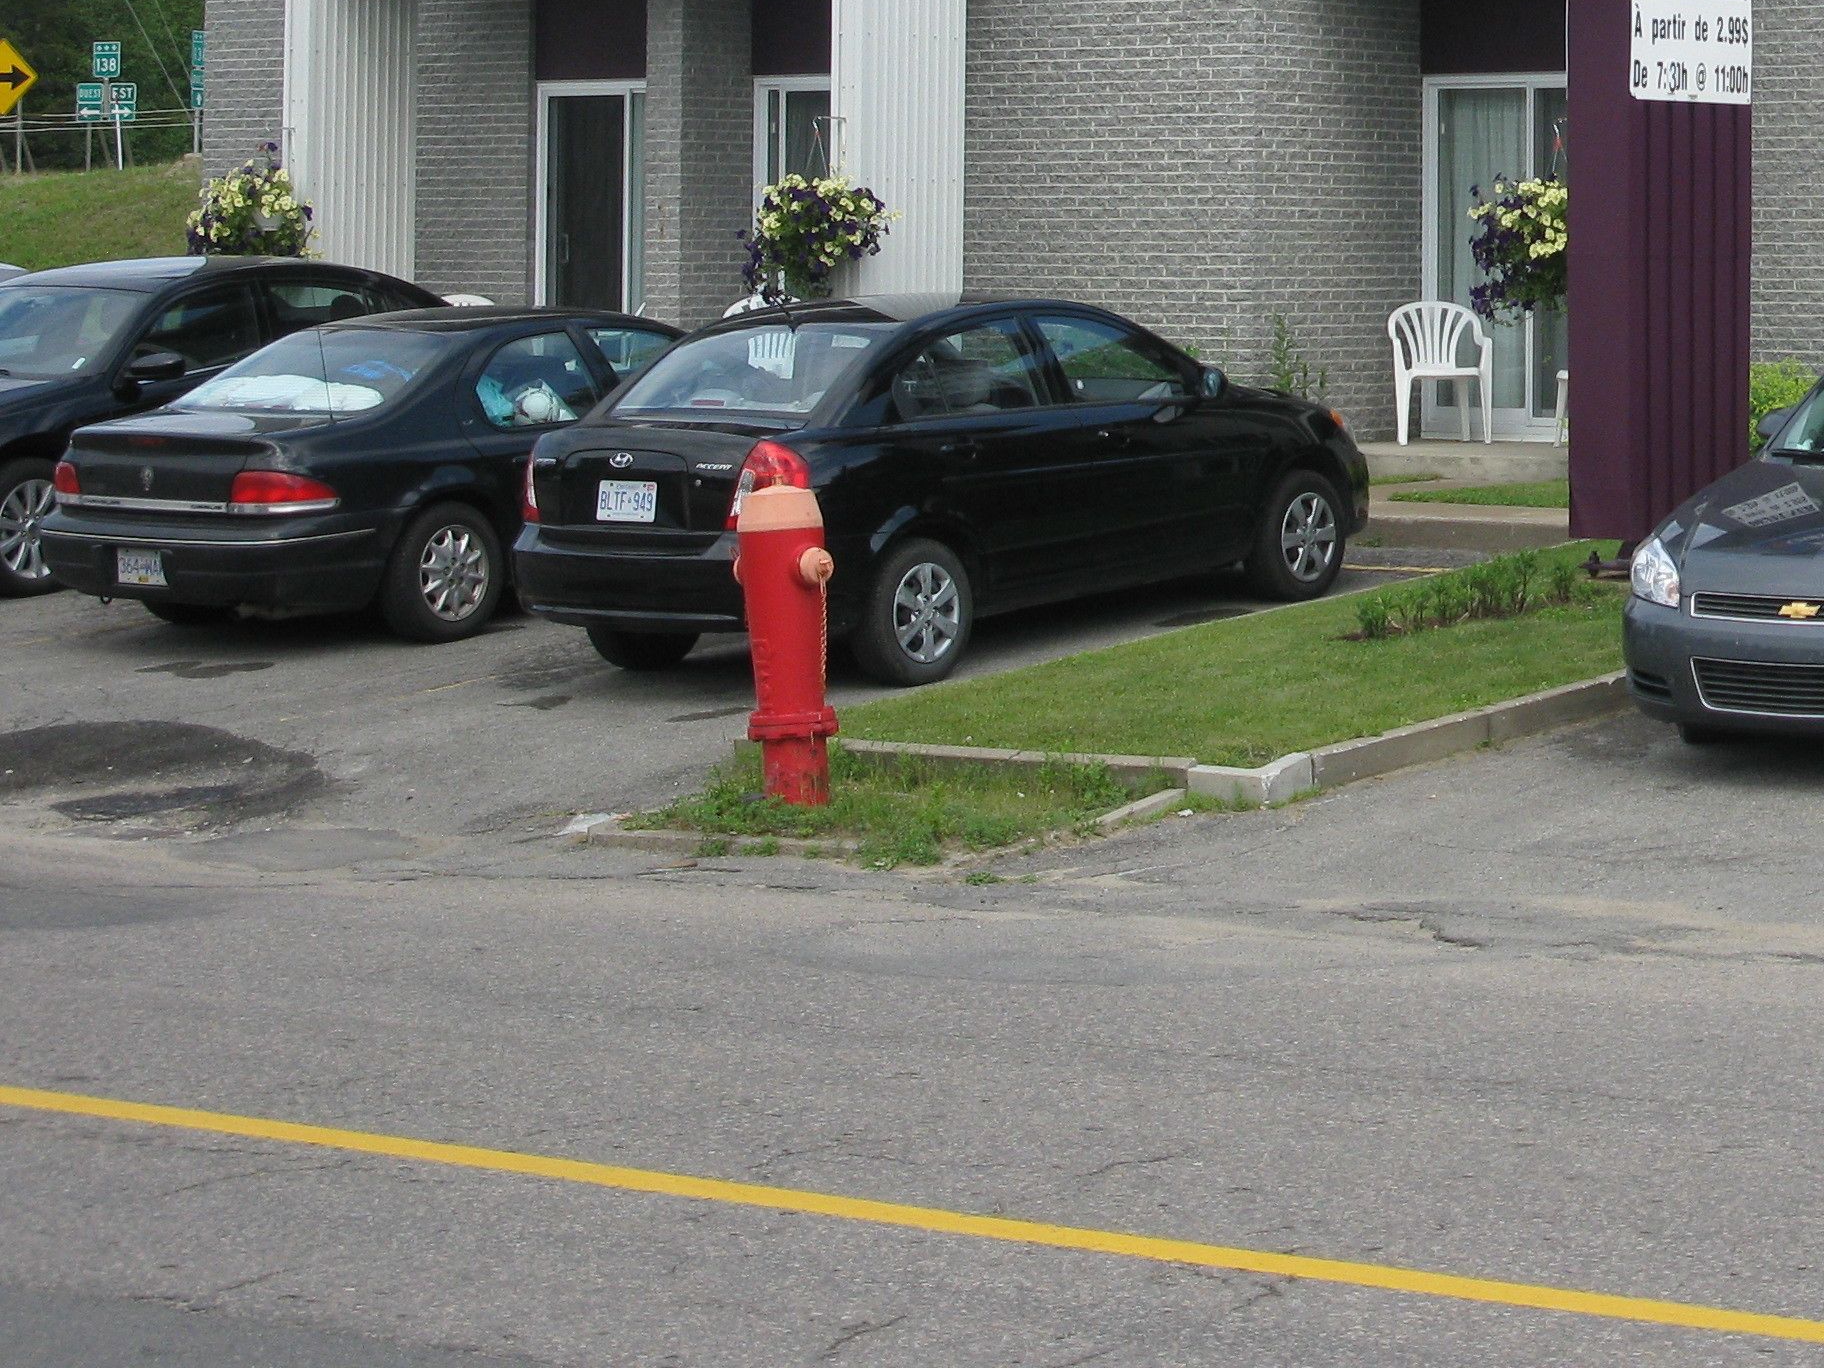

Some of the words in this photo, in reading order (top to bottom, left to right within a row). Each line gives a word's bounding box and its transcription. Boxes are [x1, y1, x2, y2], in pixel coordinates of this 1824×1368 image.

[1634, 2, 1643, 38] À
[1651, 13, 1686, 45] partir
[1694, 15, 1709, 42] de
[1716, 16, 1749, 48] 2.99$
[96, 57, 117, 72] 138
[1633, 59, 1648, 89] De
[1696, 62, 1707, 91] @
[1714, 65, 1749, 94] 11:00h
[695, 463, 733, 471] ACCENT
[600, 491, 627, 511] BLTF
[632, 492, 654, 512] 949
